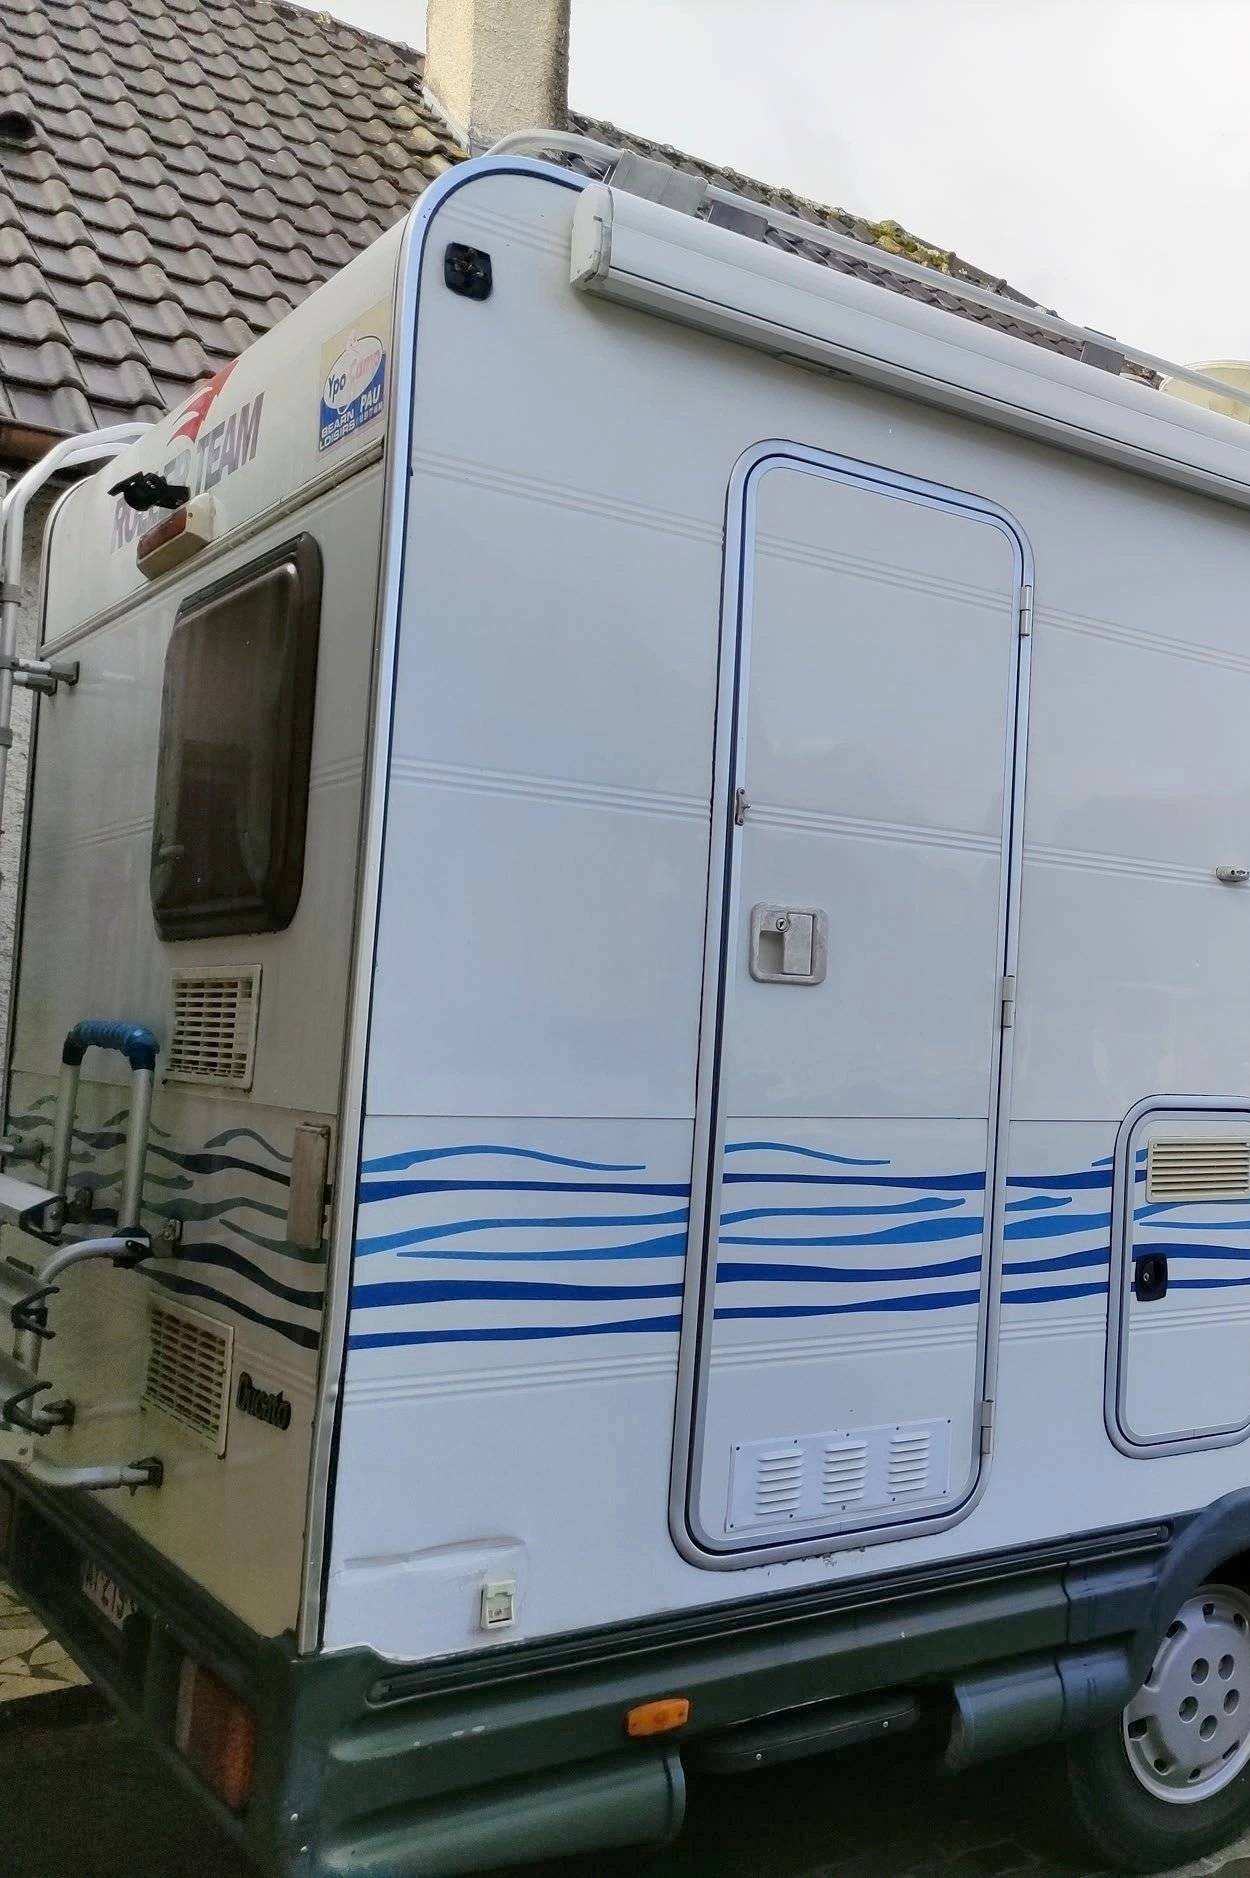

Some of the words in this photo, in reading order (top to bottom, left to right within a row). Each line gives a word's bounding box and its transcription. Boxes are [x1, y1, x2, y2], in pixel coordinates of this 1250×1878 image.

[360, 383, 381, 413] PAU
[320, 419, 356, 450] LOISIRS
[321, 409, 354, 438] BEARN
[197, 392, 265, 495] TEAM
